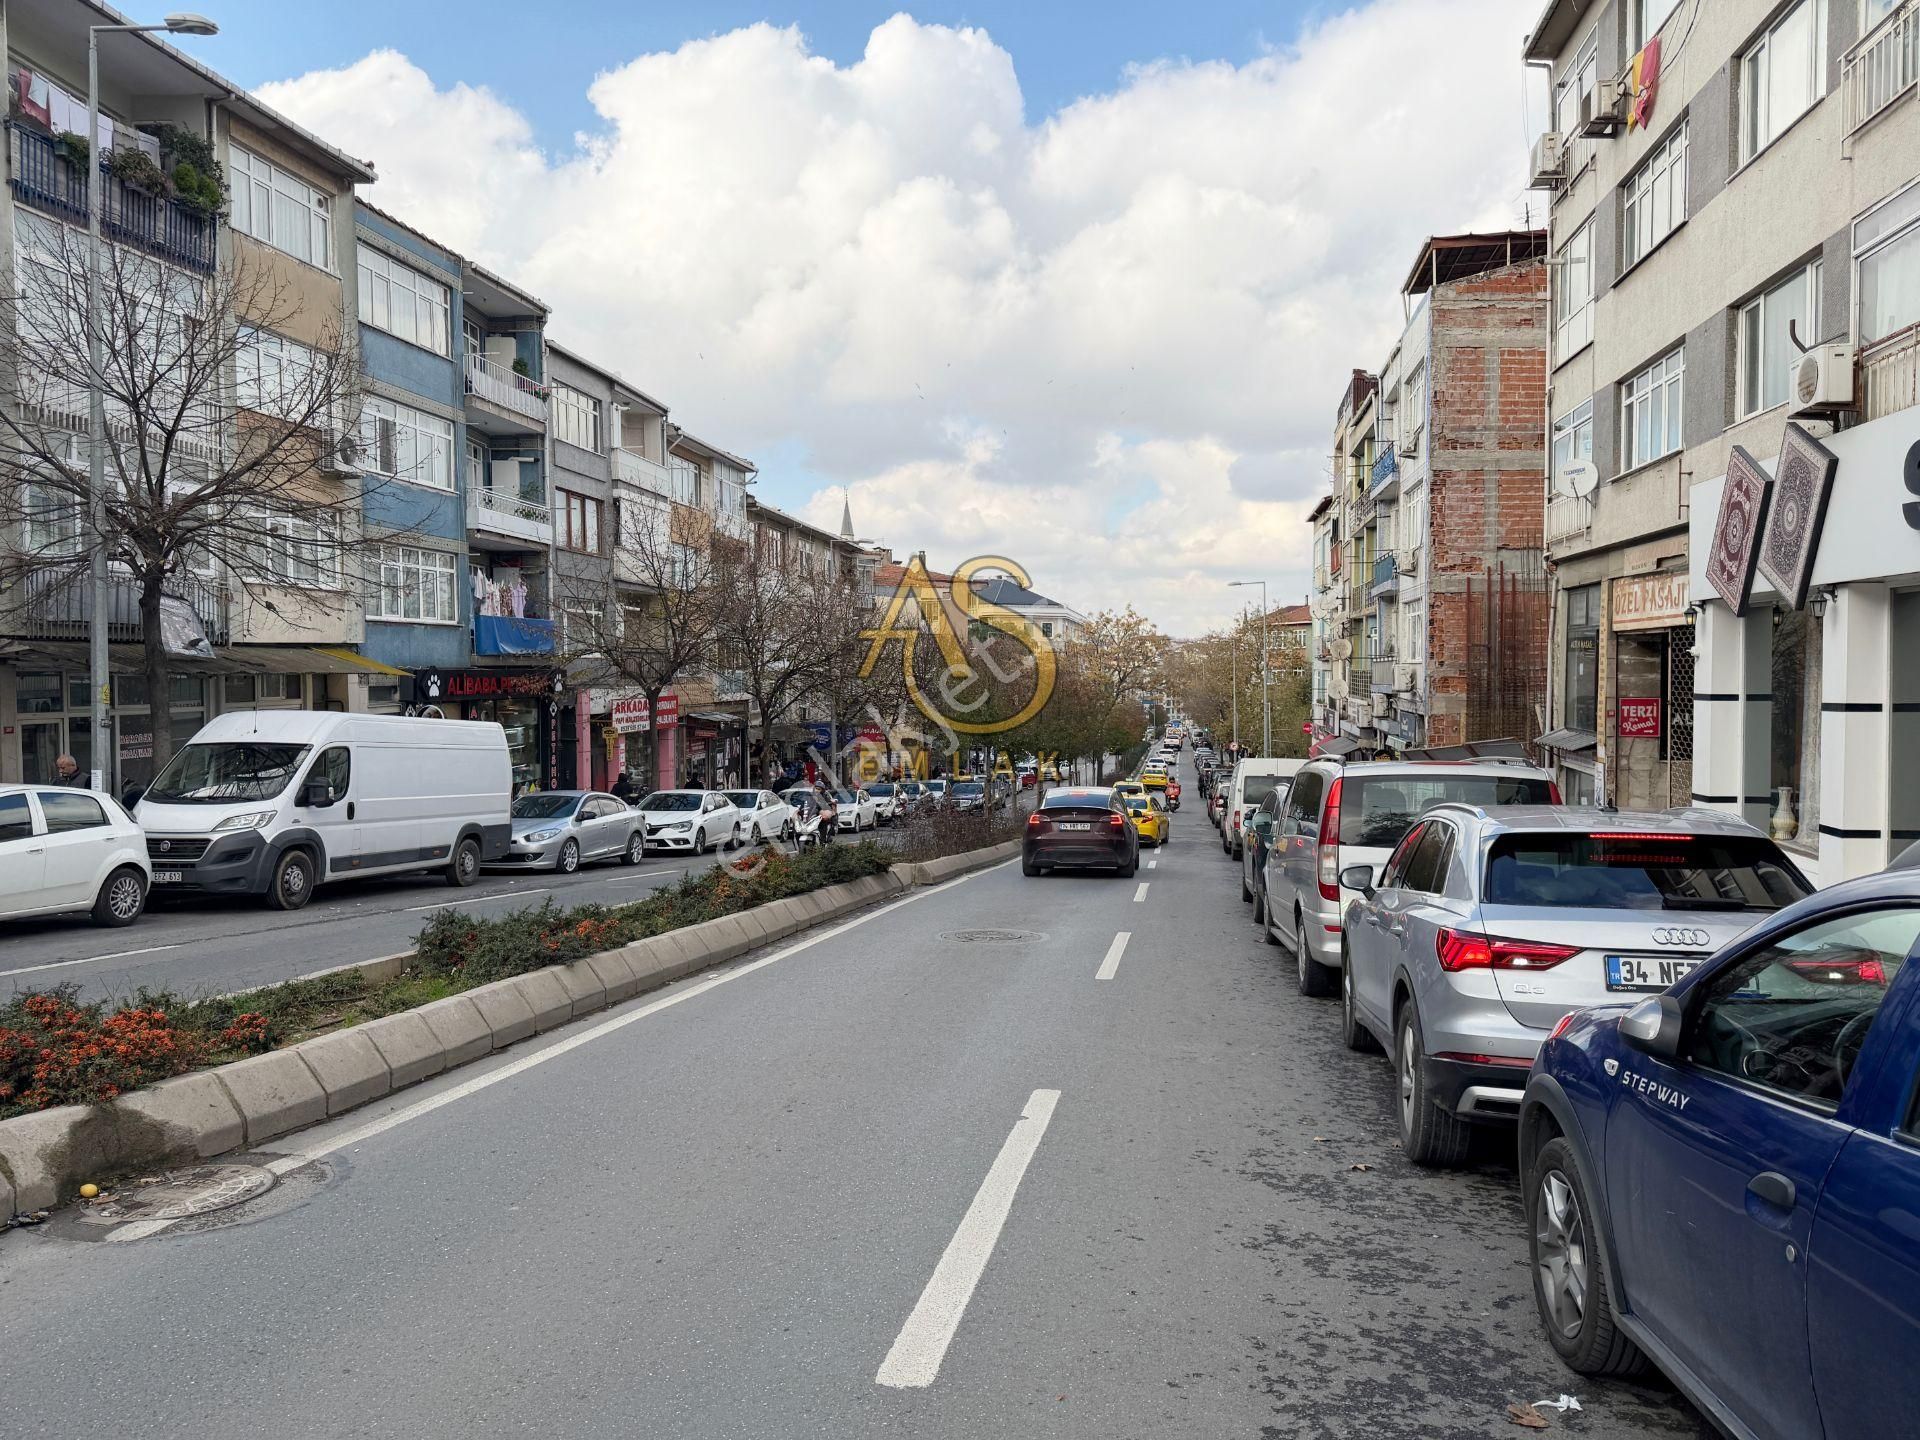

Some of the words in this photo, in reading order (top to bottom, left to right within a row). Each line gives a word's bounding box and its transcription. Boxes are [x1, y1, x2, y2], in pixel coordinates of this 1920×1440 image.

[615, 699, 651, 714] ARKADA
[1621, 703, 1657, 718] TERZİ
[1622, 717, 1656, 733] Kemal
[1611, 972, 1620, 980] TR
[1621, 960, 1649, 984] 34
[1622, 1070, 1690, 1110] STEPWAY
